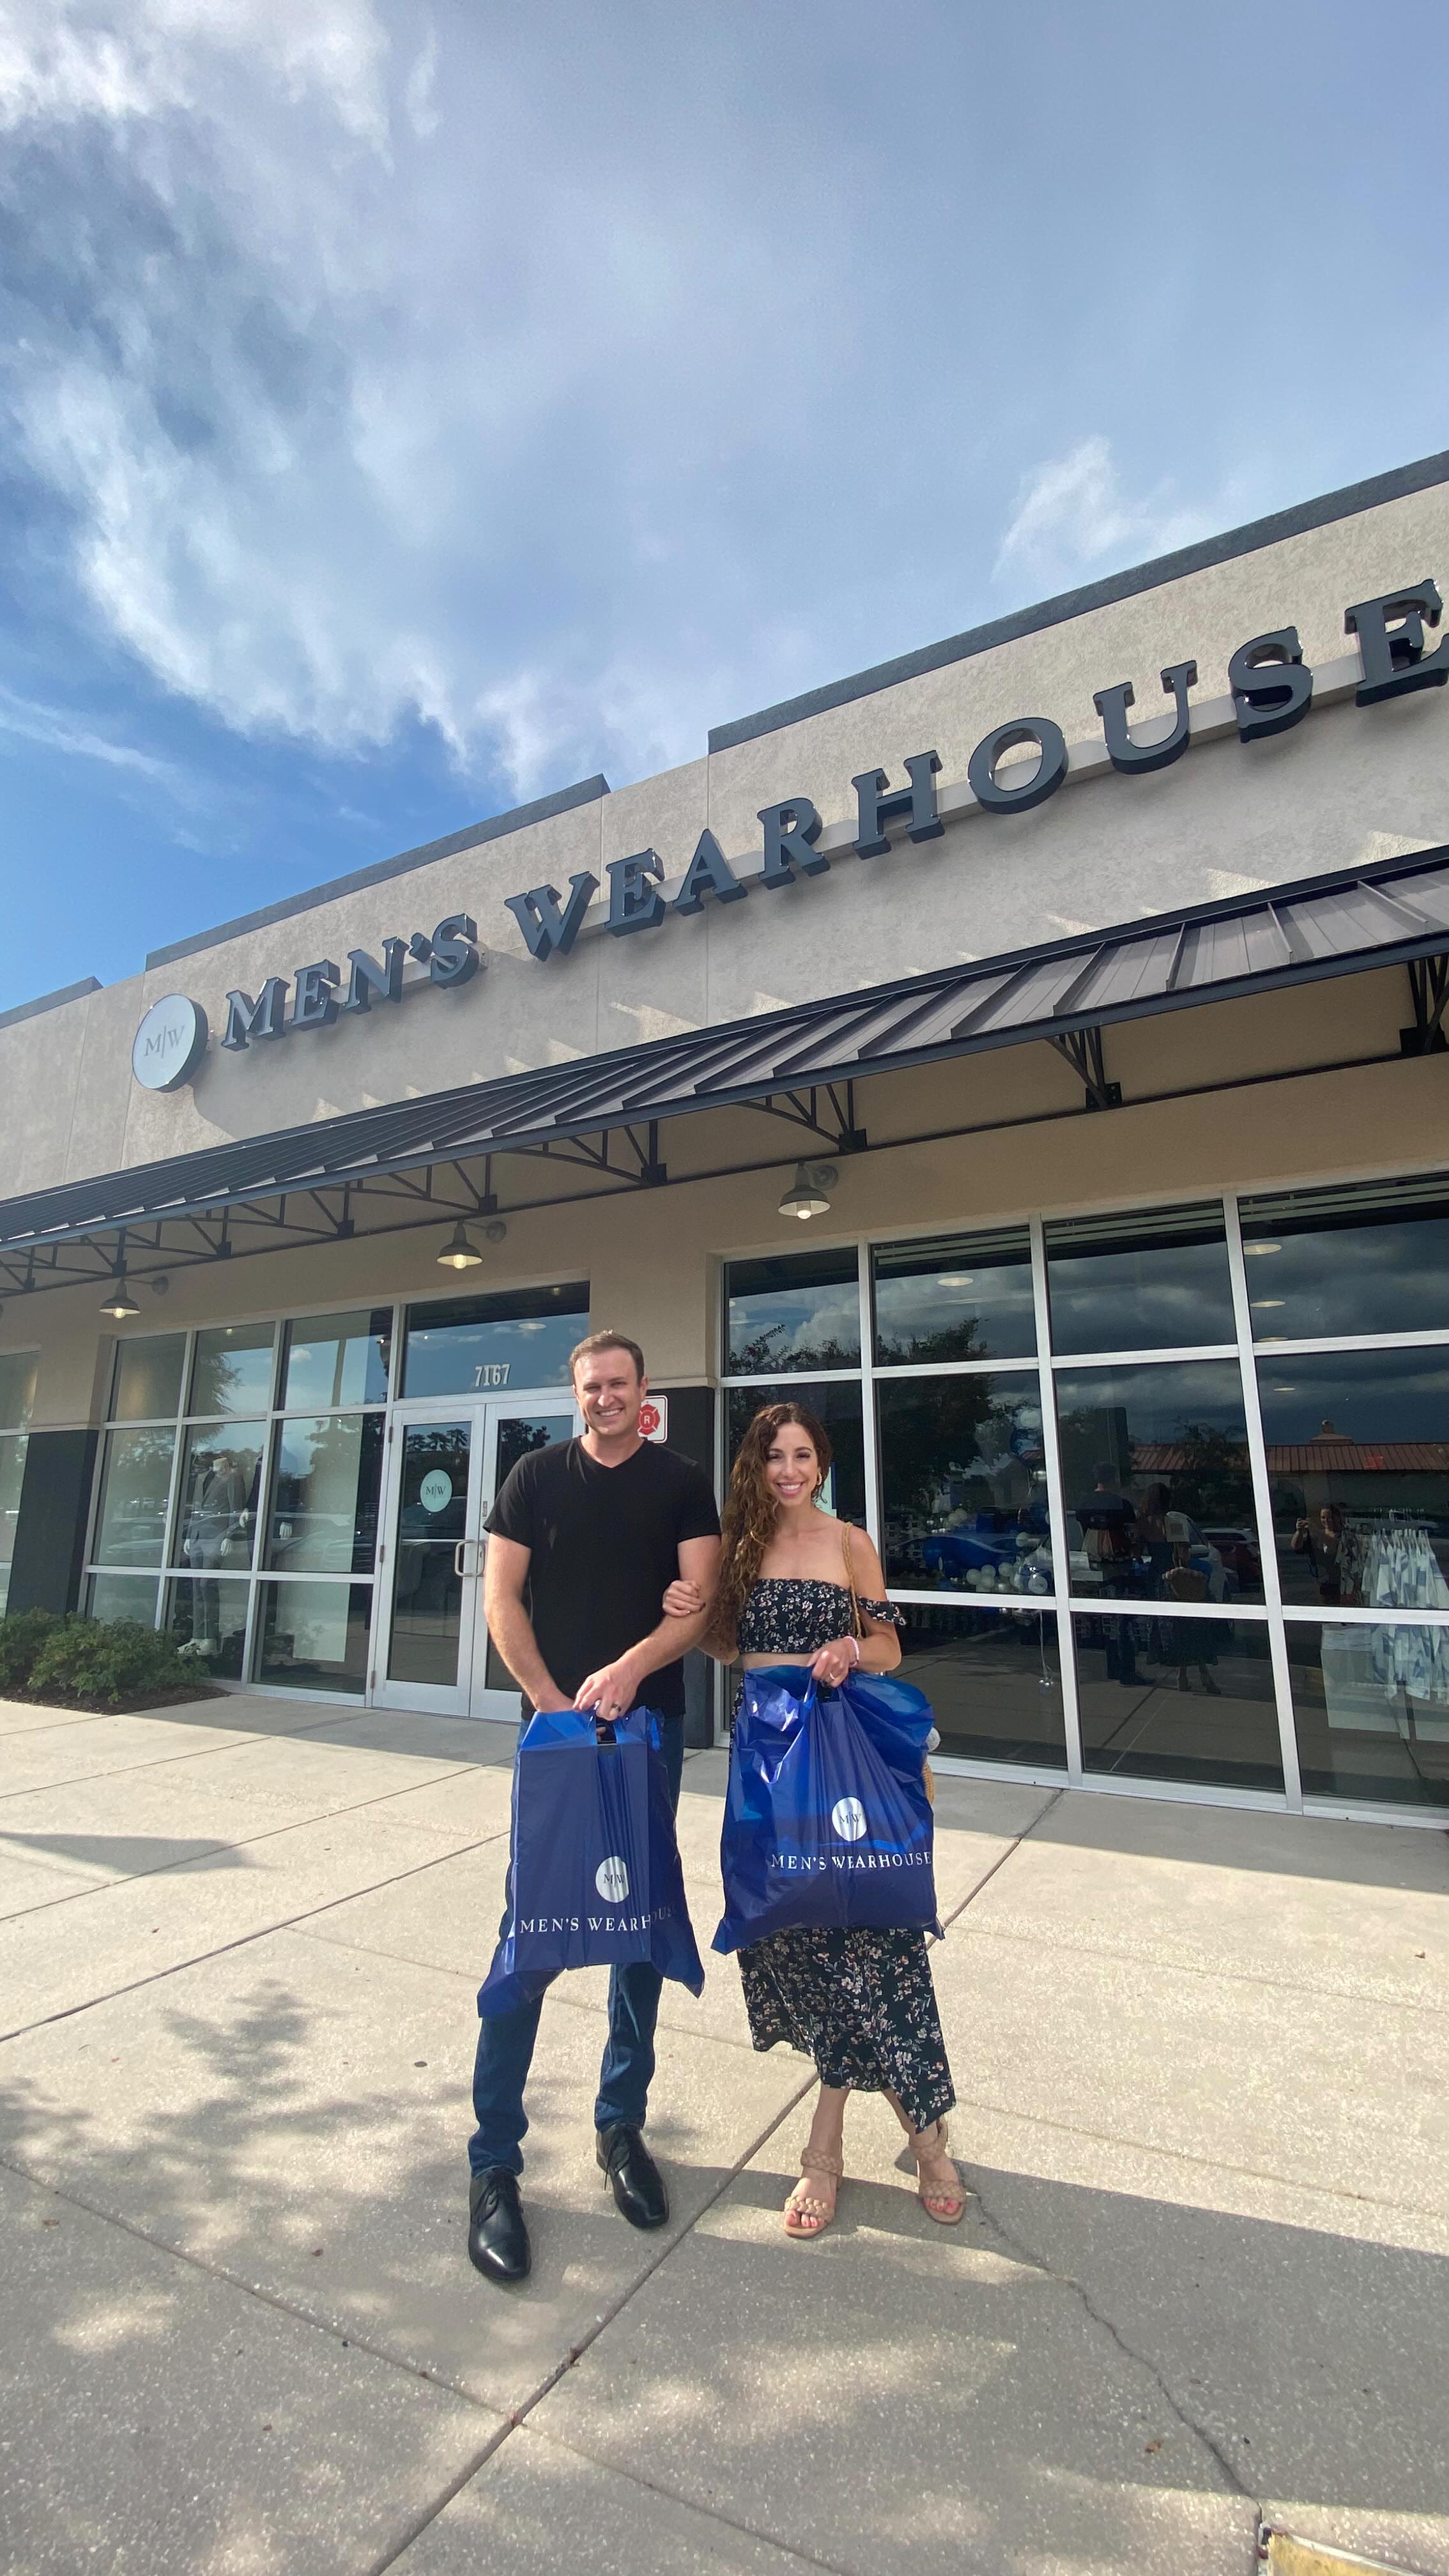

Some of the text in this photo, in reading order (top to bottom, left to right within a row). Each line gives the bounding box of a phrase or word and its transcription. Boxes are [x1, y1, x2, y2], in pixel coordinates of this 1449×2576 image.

[221, 913, 479, 1052] MEN'S
[504, 579, 1449, 962] WEARHOUSE
[475, 1363, 510, 1387] 7167
[644, 1415, 650, 1424] R
[771, 1851, 932, 1871] MEN'S WEARHOUSE
[519, 1917, 579, 1933] MEN'S
